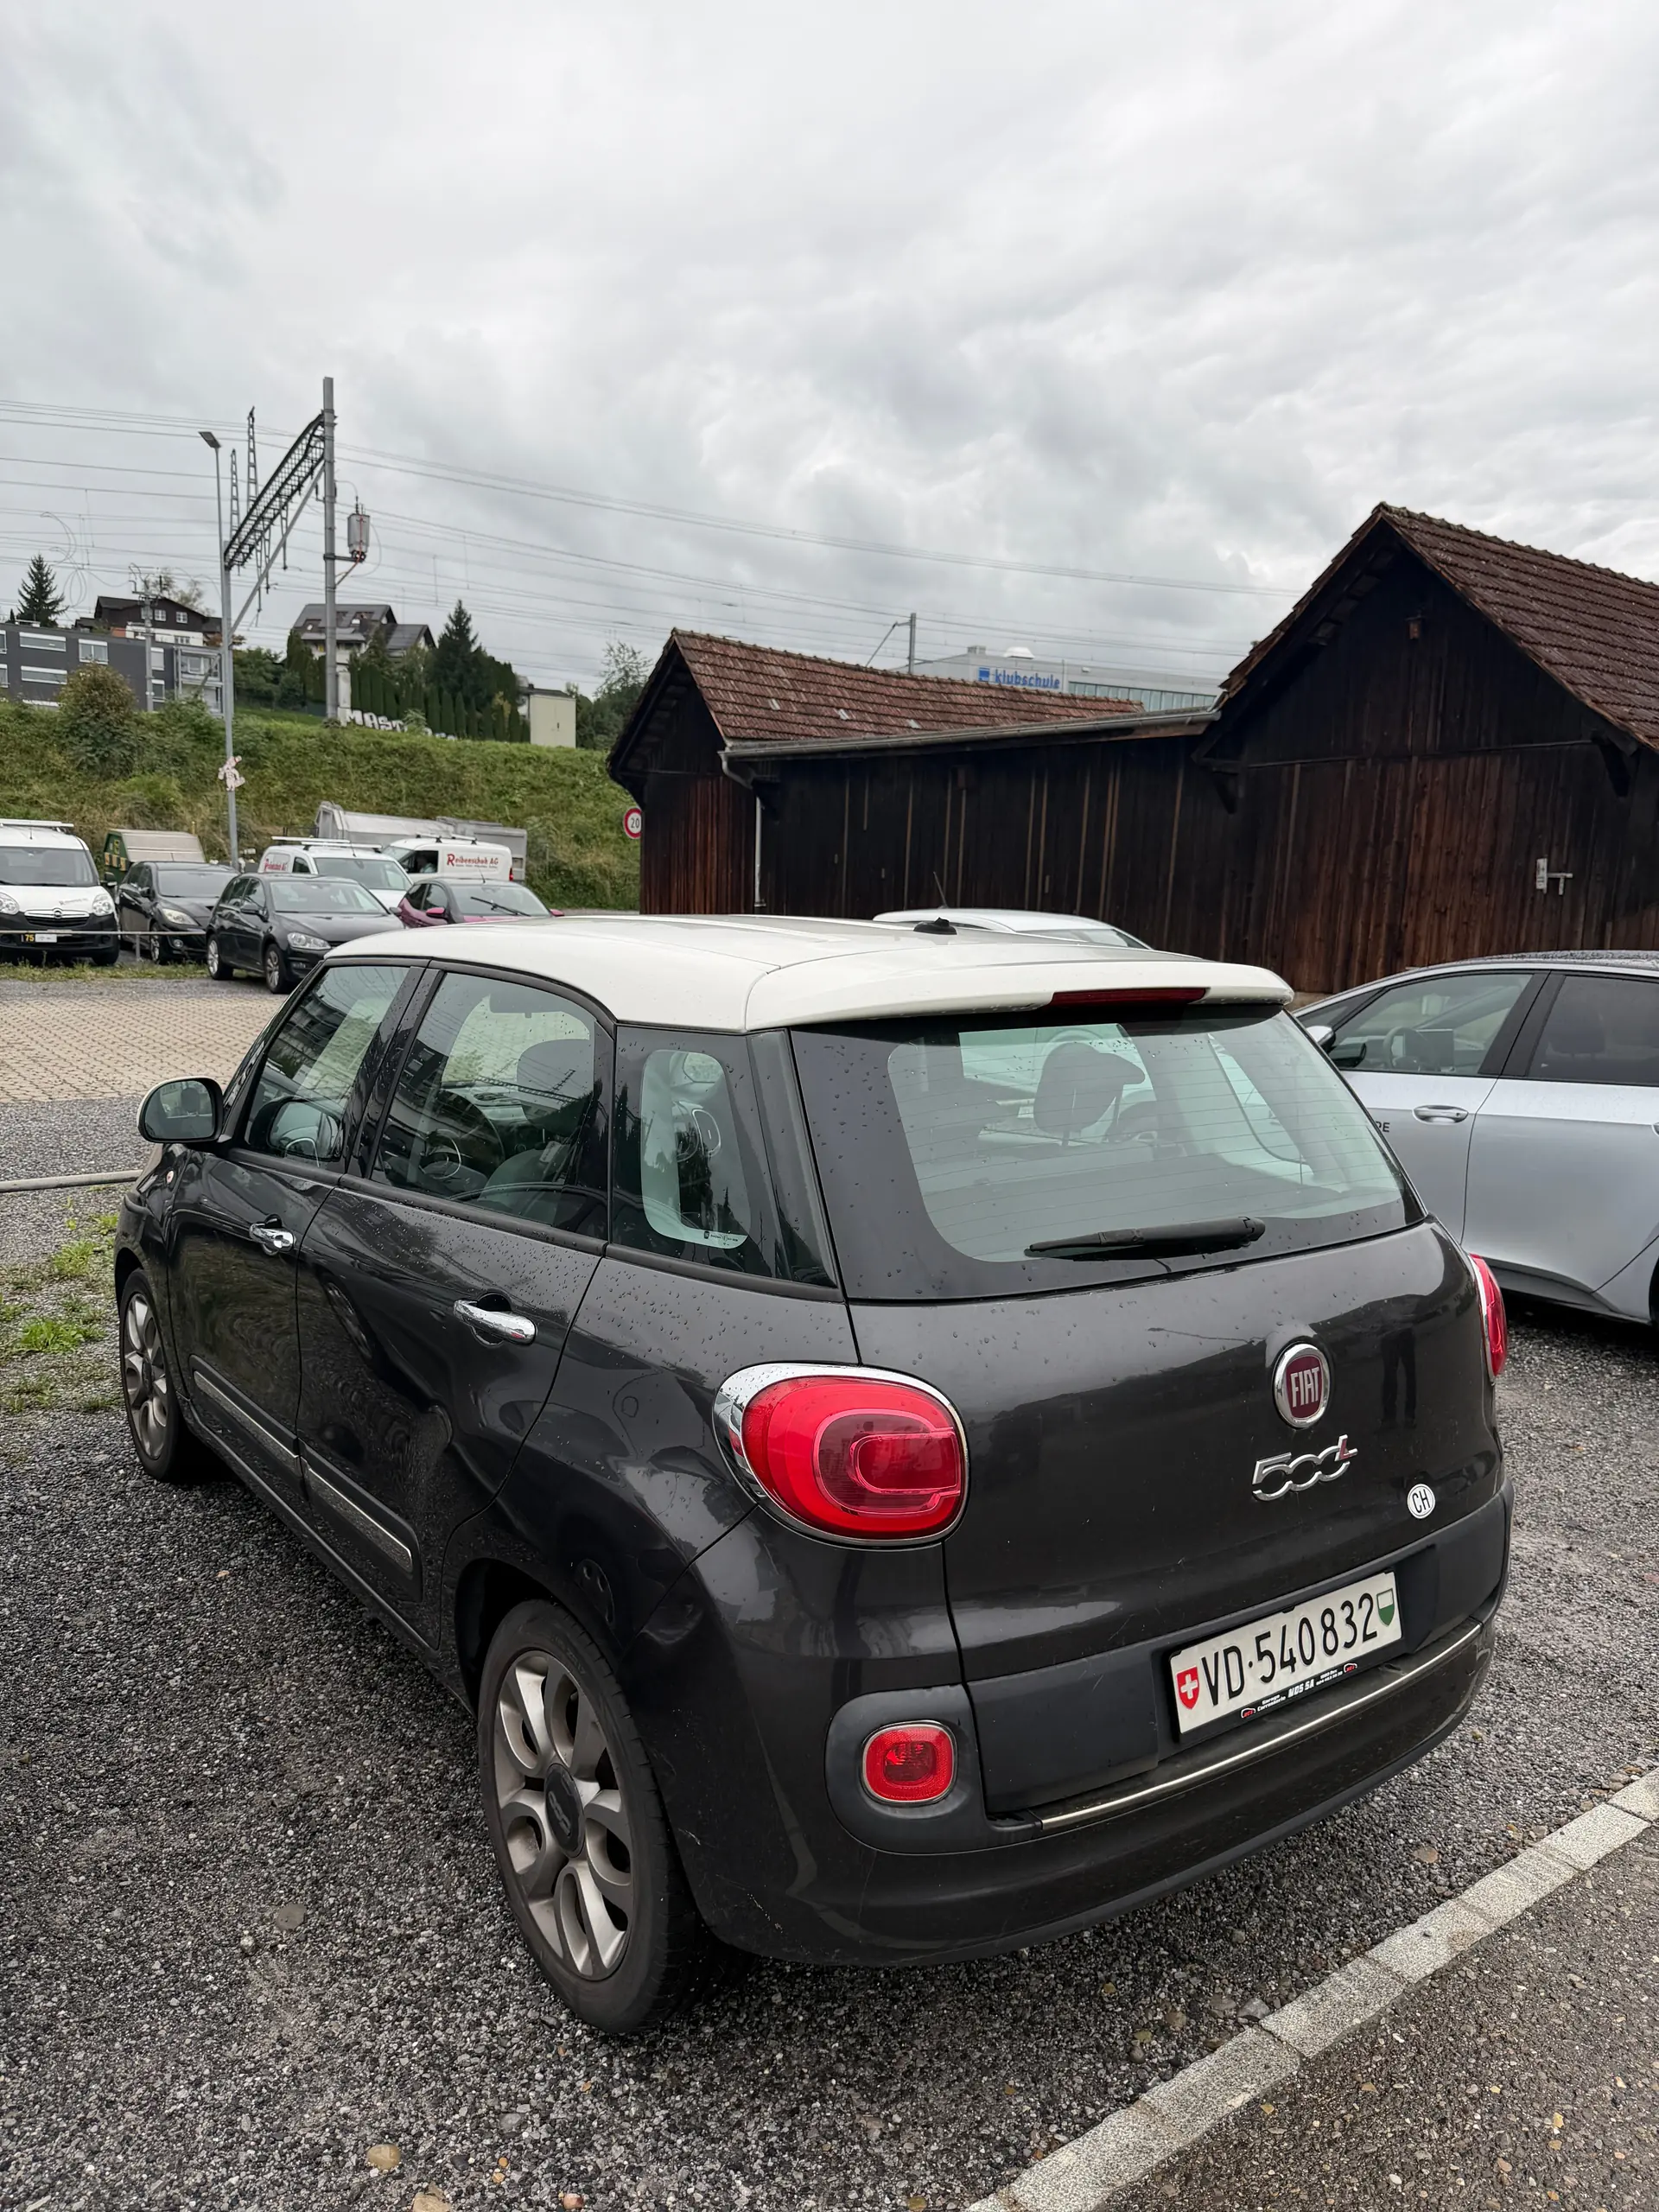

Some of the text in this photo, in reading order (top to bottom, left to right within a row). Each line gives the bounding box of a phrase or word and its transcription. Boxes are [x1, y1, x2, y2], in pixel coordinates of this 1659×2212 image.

[995, 669, 1060, 689] klubschule
[631, 817, 639, 829] 20
[490, 857, 499, 866] AG
[1290, 1366, 1319, 1408] FIAT
[1412, 1489, 1431, 1514] CH
[1305, 1679, 1314, 1691] SA
